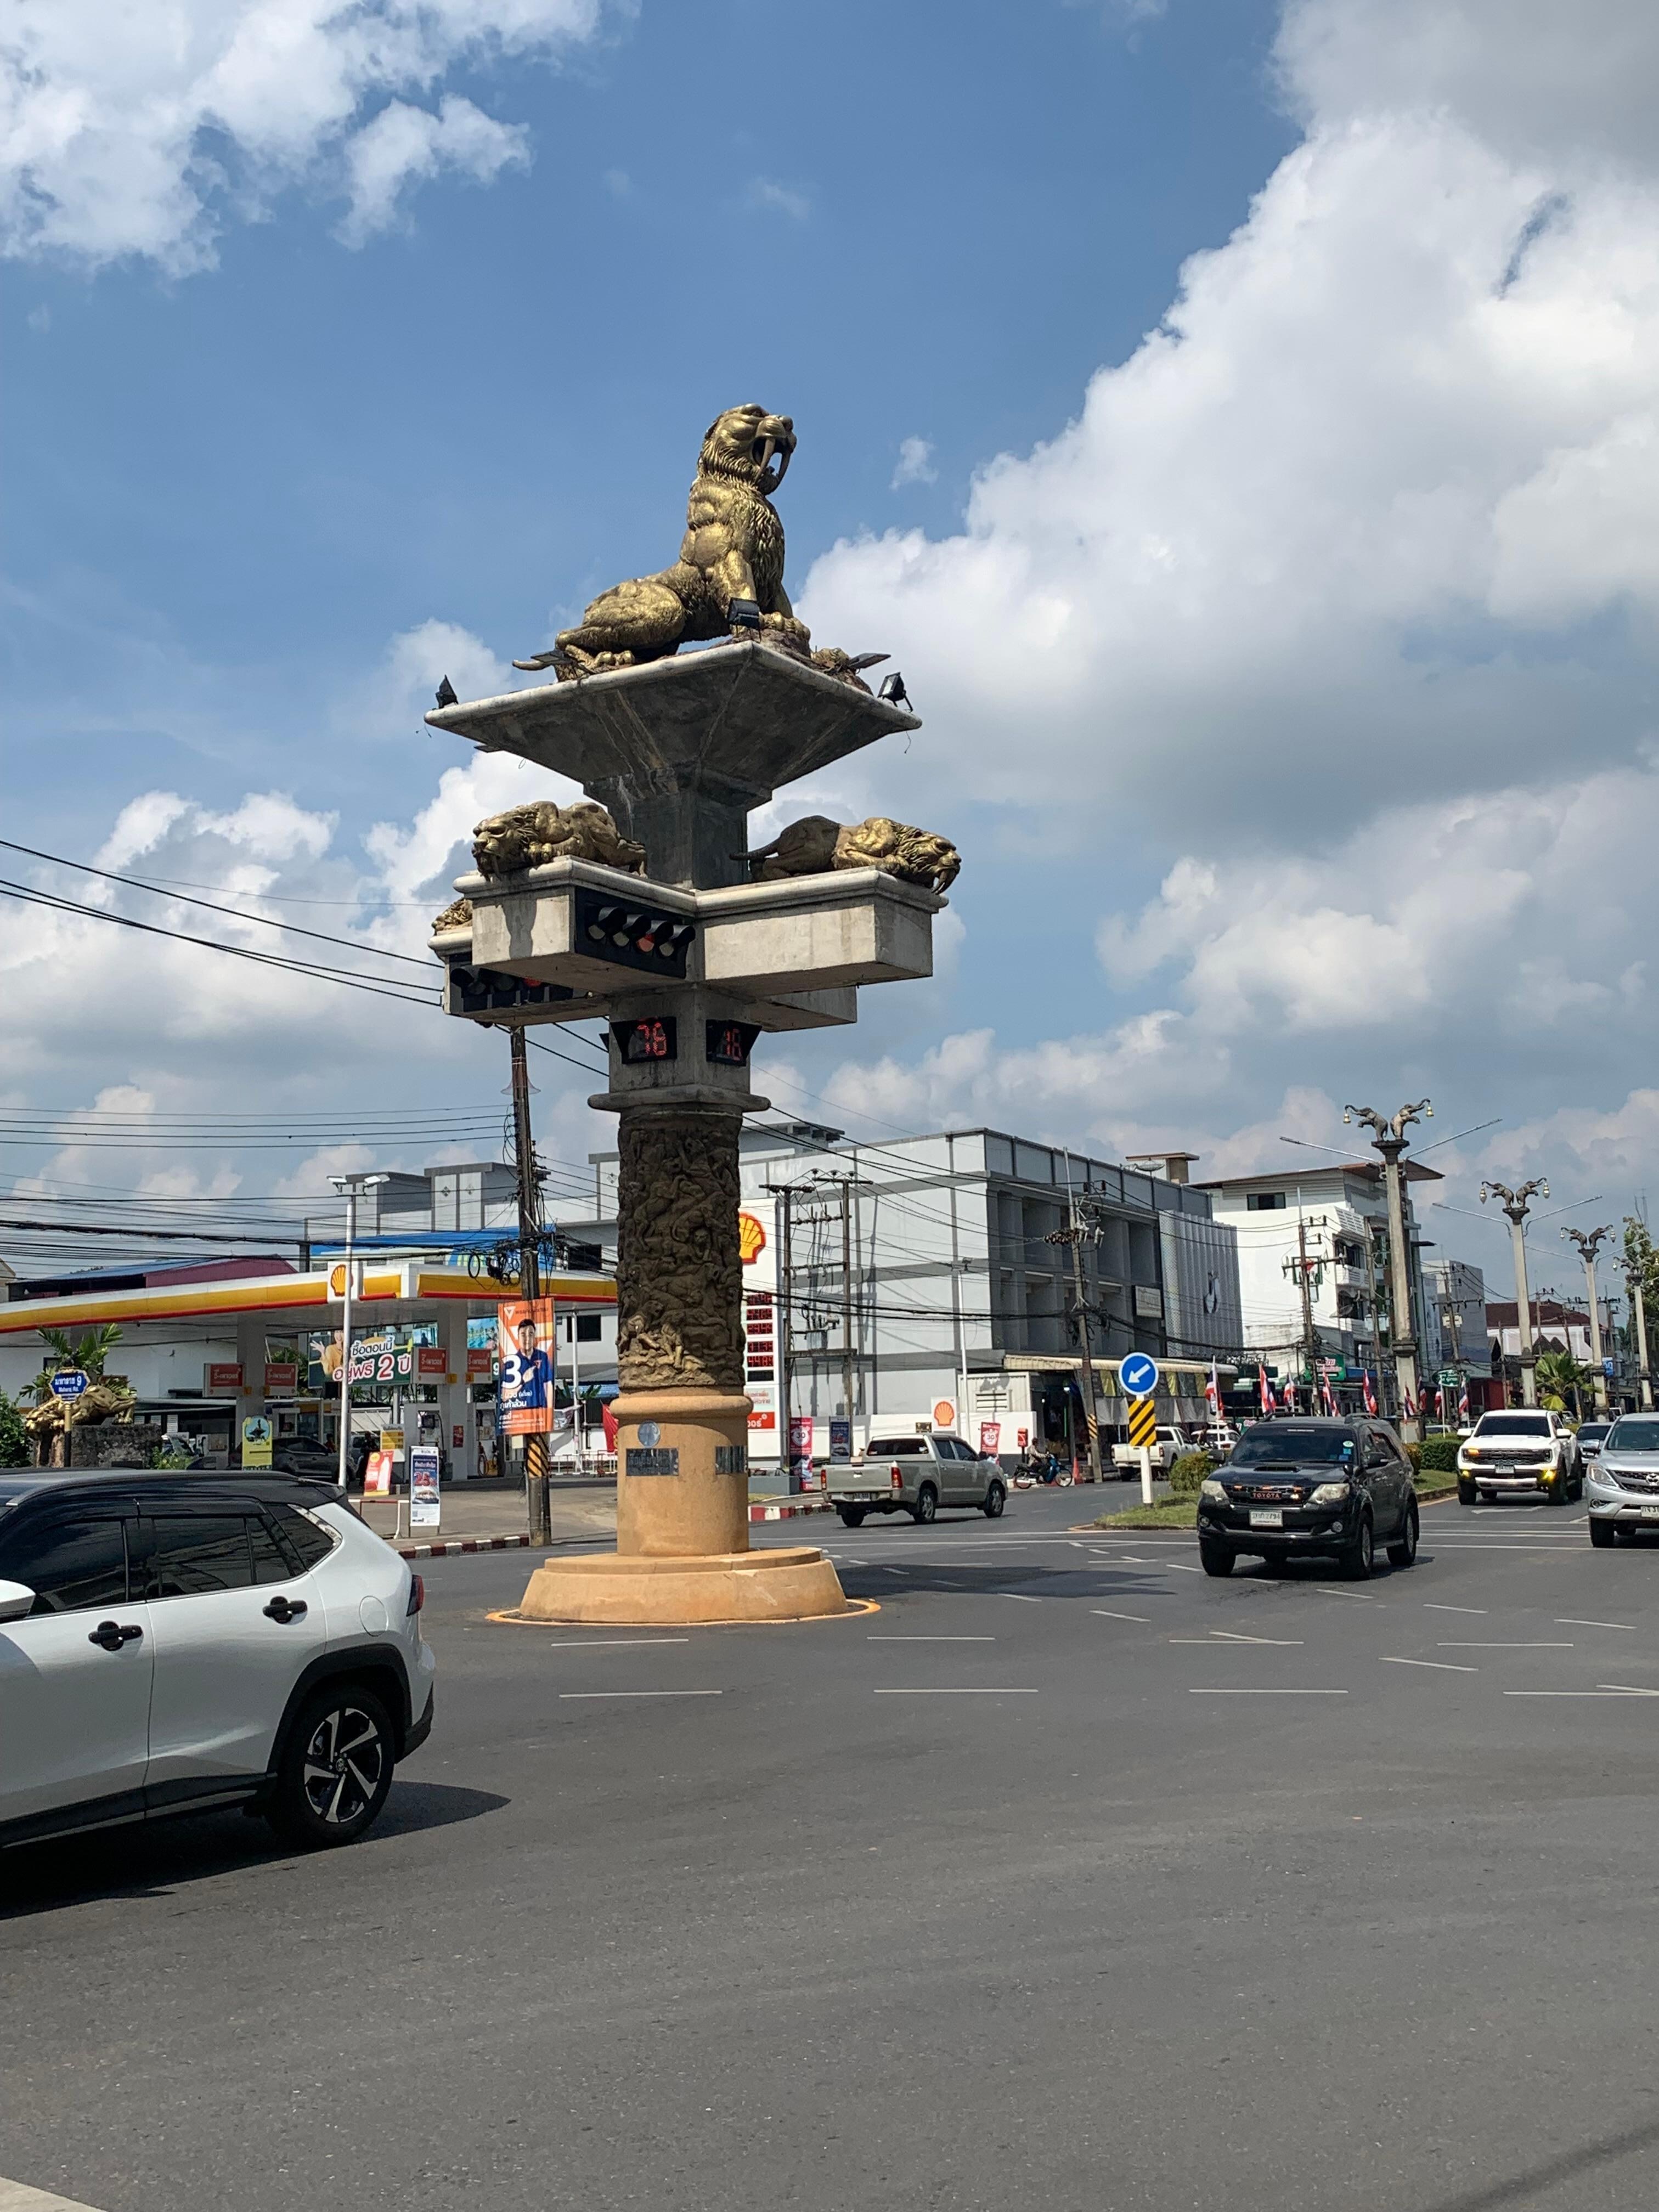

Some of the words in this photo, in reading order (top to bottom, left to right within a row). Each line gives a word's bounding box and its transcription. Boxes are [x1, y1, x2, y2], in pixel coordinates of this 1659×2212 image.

[379, 1356, 393, 1378] 2
[399, 1356, 410, 1372] ปี
[501, 1354, 521, 1389] 3
[77, 1375, 82, 1386] 9
